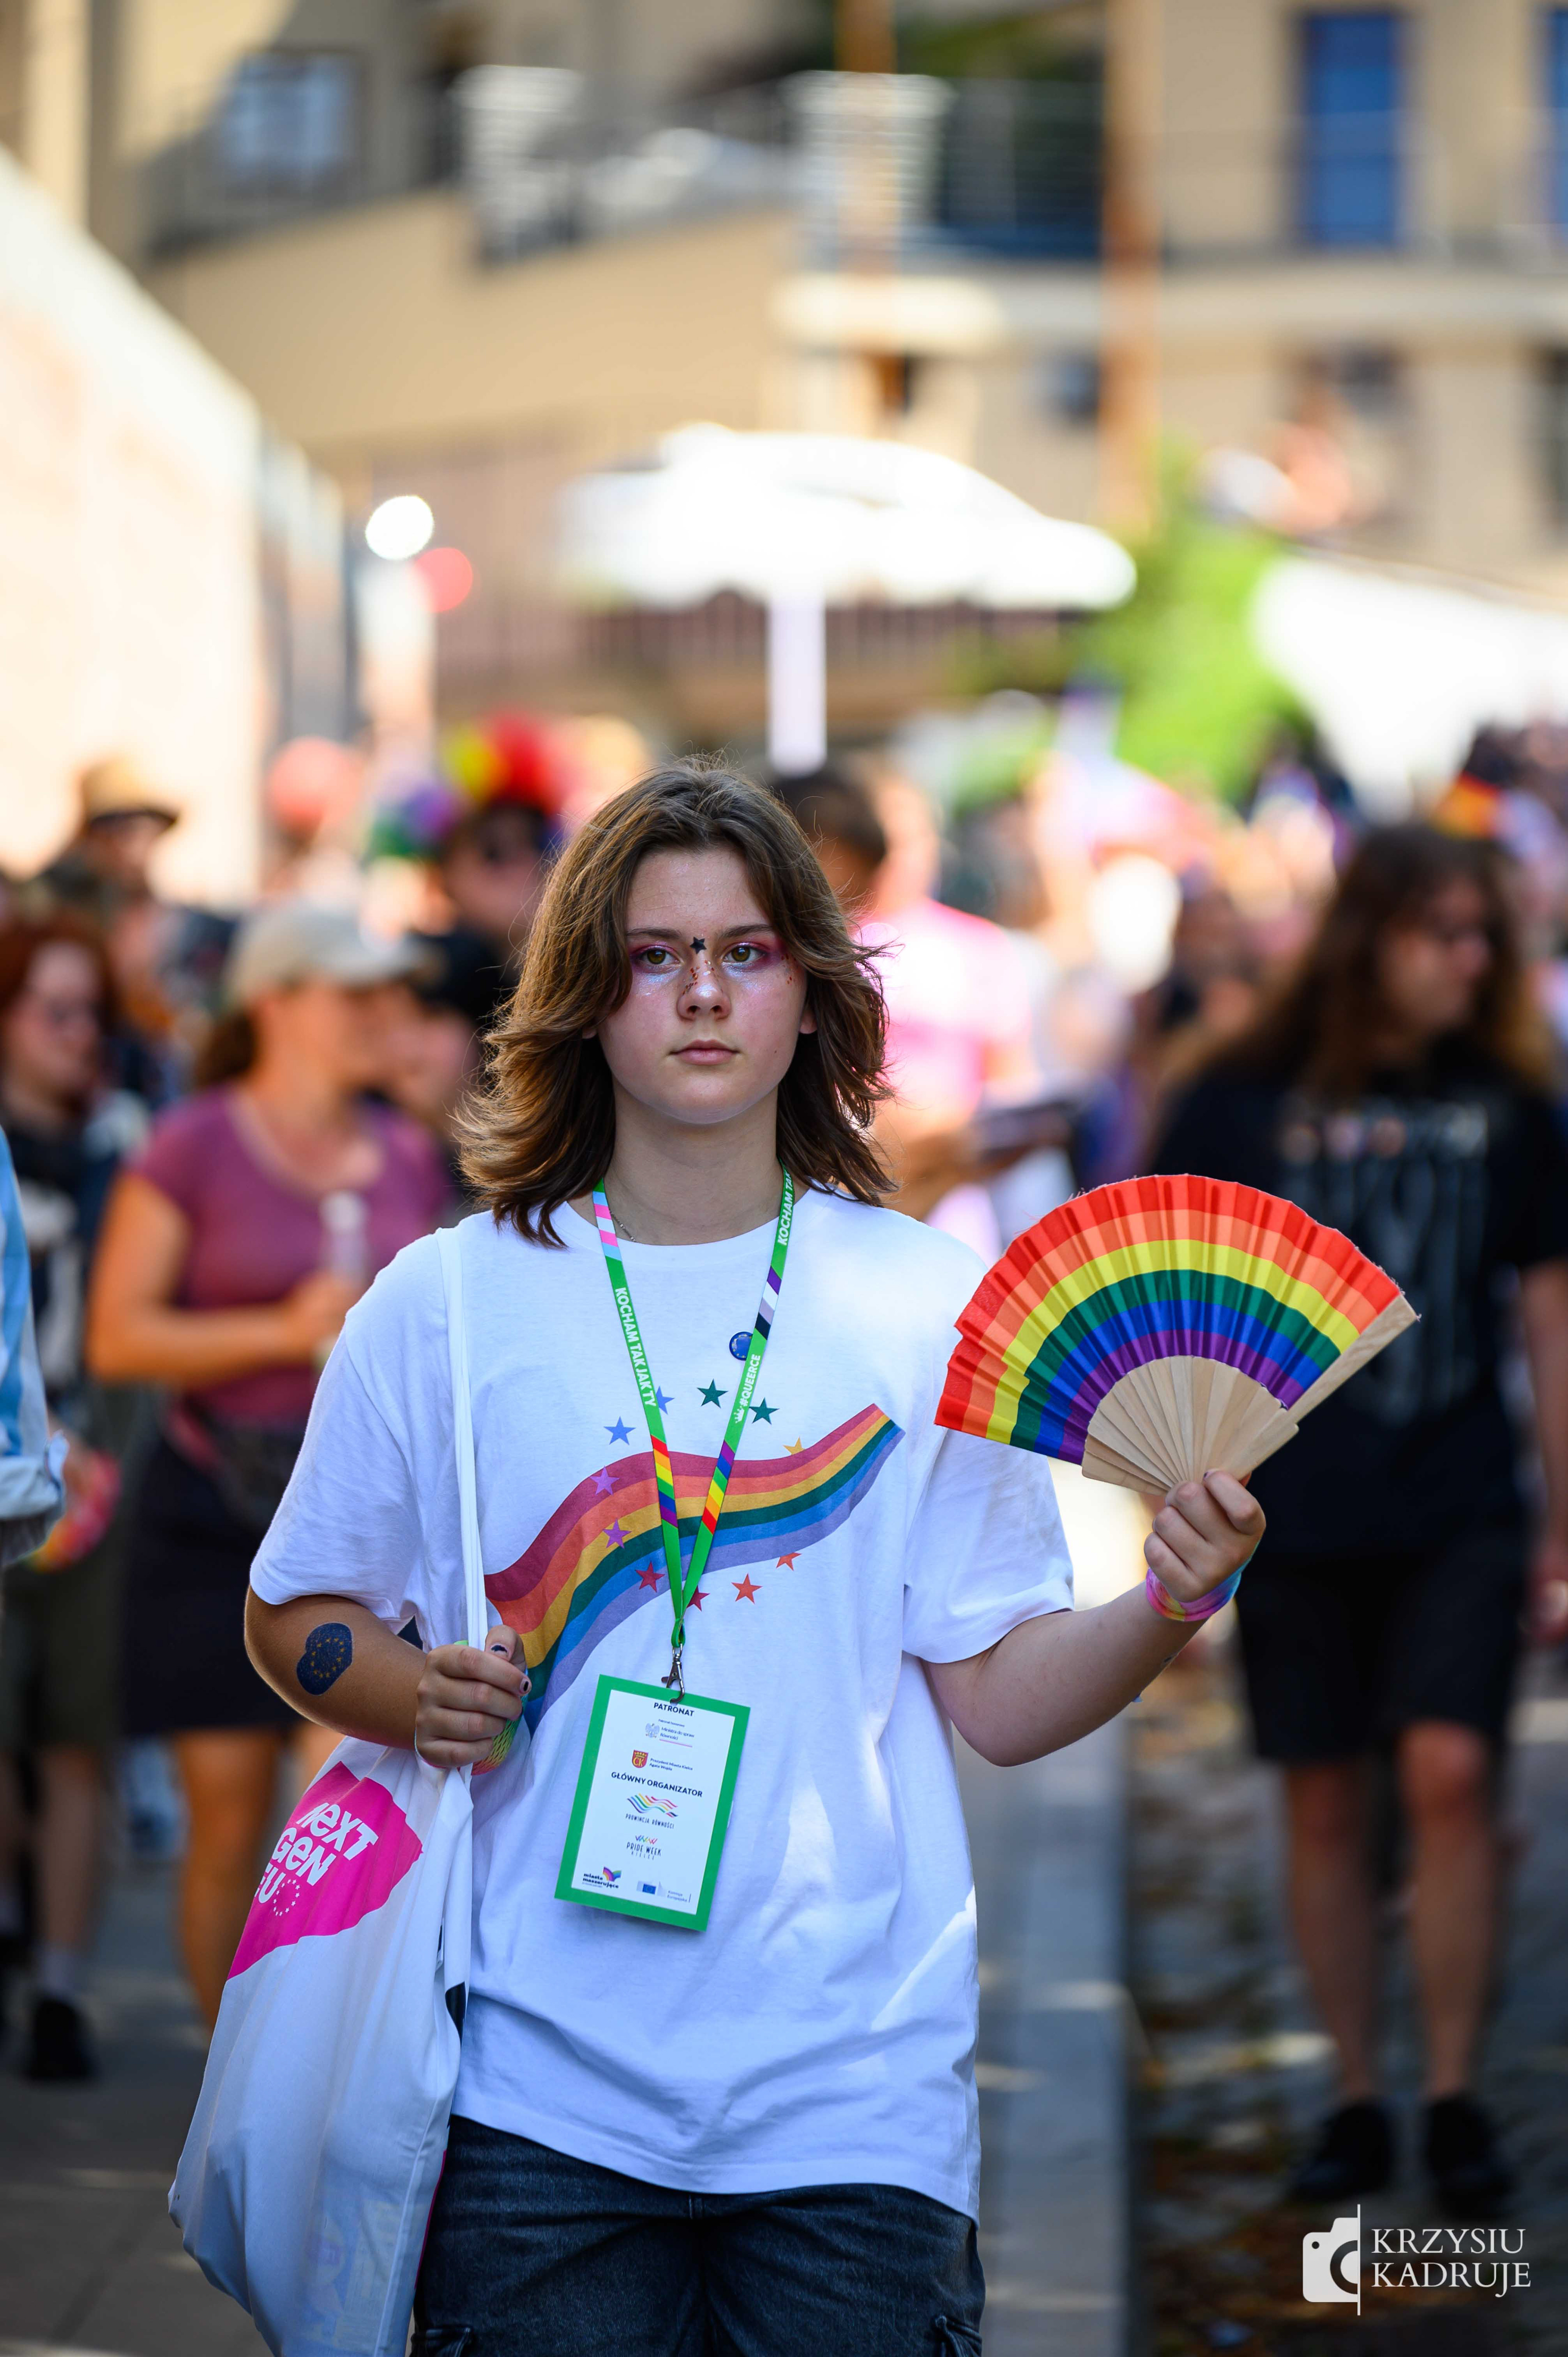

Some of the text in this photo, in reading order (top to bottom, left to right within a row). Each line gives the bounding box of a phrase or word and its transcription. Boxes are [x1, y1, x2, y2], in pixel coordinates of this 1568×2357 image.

[777, 1191, 793, 1246] KOCHAM
[615, 1287, 656, 1407] KOCHAM TAK JAK TY
[739, 1354, 761, 1407] #QUEERCE
[654, 1702, 695, 1716] PATRONAT
[611, 1772, 703, 1797] GŁÓWNY ORGANIZATOR
[626, 1813, 674, 1829] PROWINCJA RÓWNOŚCI
[626, 1842, 662, 1856] PRIDE WEEK
